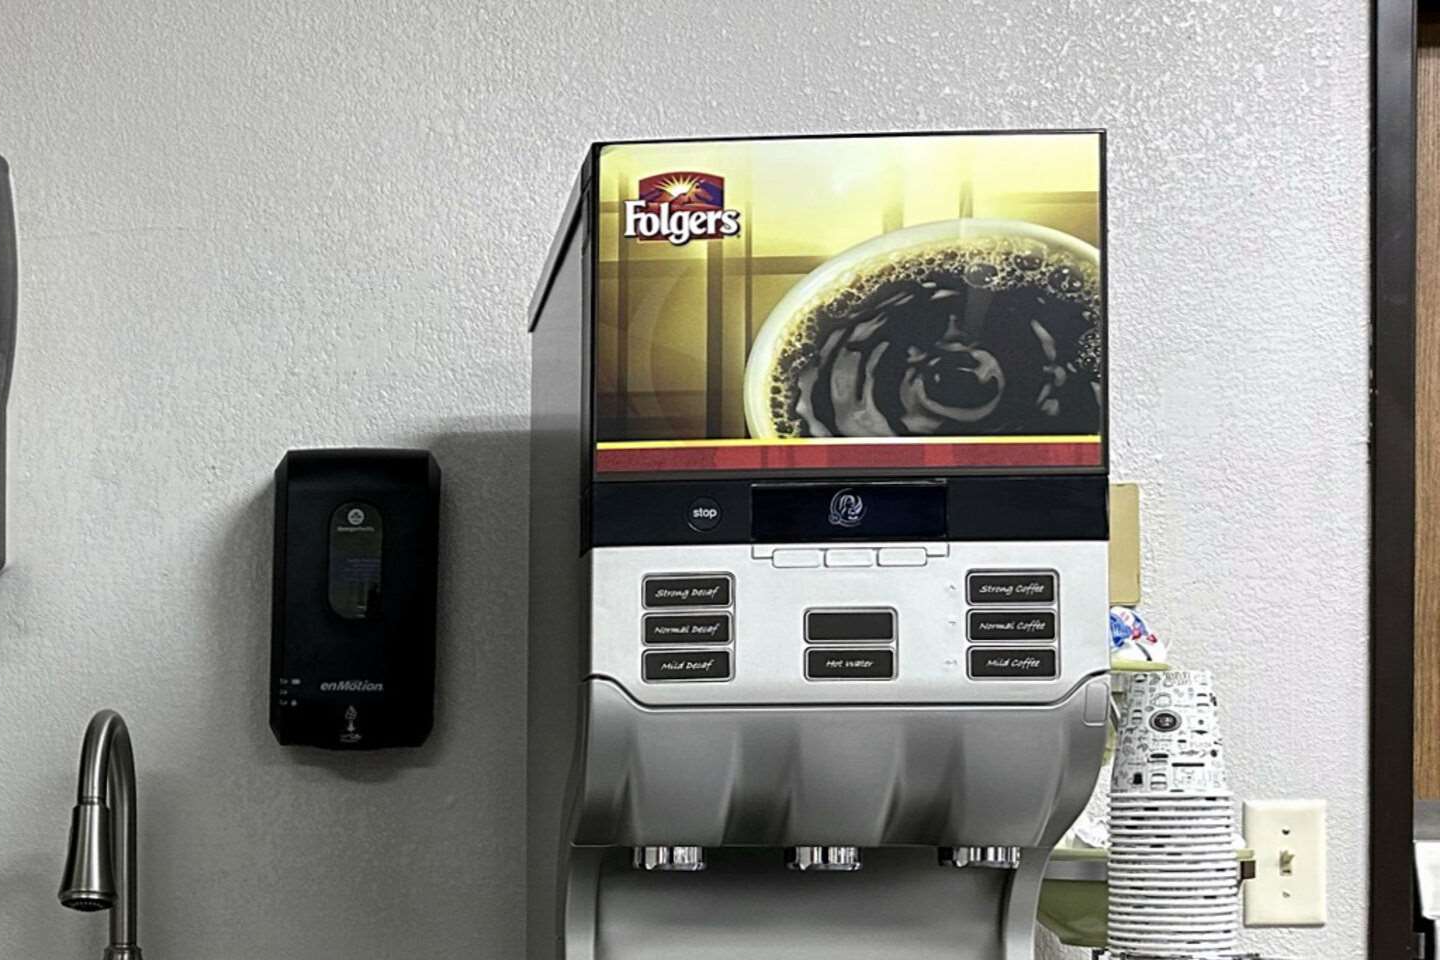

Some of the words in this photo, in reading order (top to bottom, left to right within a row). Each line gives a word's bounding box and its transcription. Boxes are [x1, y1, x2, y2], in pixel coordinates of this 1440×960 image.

[624, 200, 740, 245] Folgers
[692, 507, 718, 519] stop
[655, 588, 690, 600] Strong
[691, 585, 720, 599] Decaf
[979, 585, 1014, 596] Strong
[1015, 583, 1045, 596] Coffee
[654, 625, 690, 635] Normal
[691, 623, 720, 637] Decaf
[979, 621, 1015, 631] Normal
[1016, 619, 1047, 632] Coffee
[661, 660, 685, 671] Mild
[686, 659, 715, 672] Decaf
[986, 657, 1010, 667] Mild
[1010, 656, 1041, 670] Coffee
[320, 679, 384, 692] enMotion
